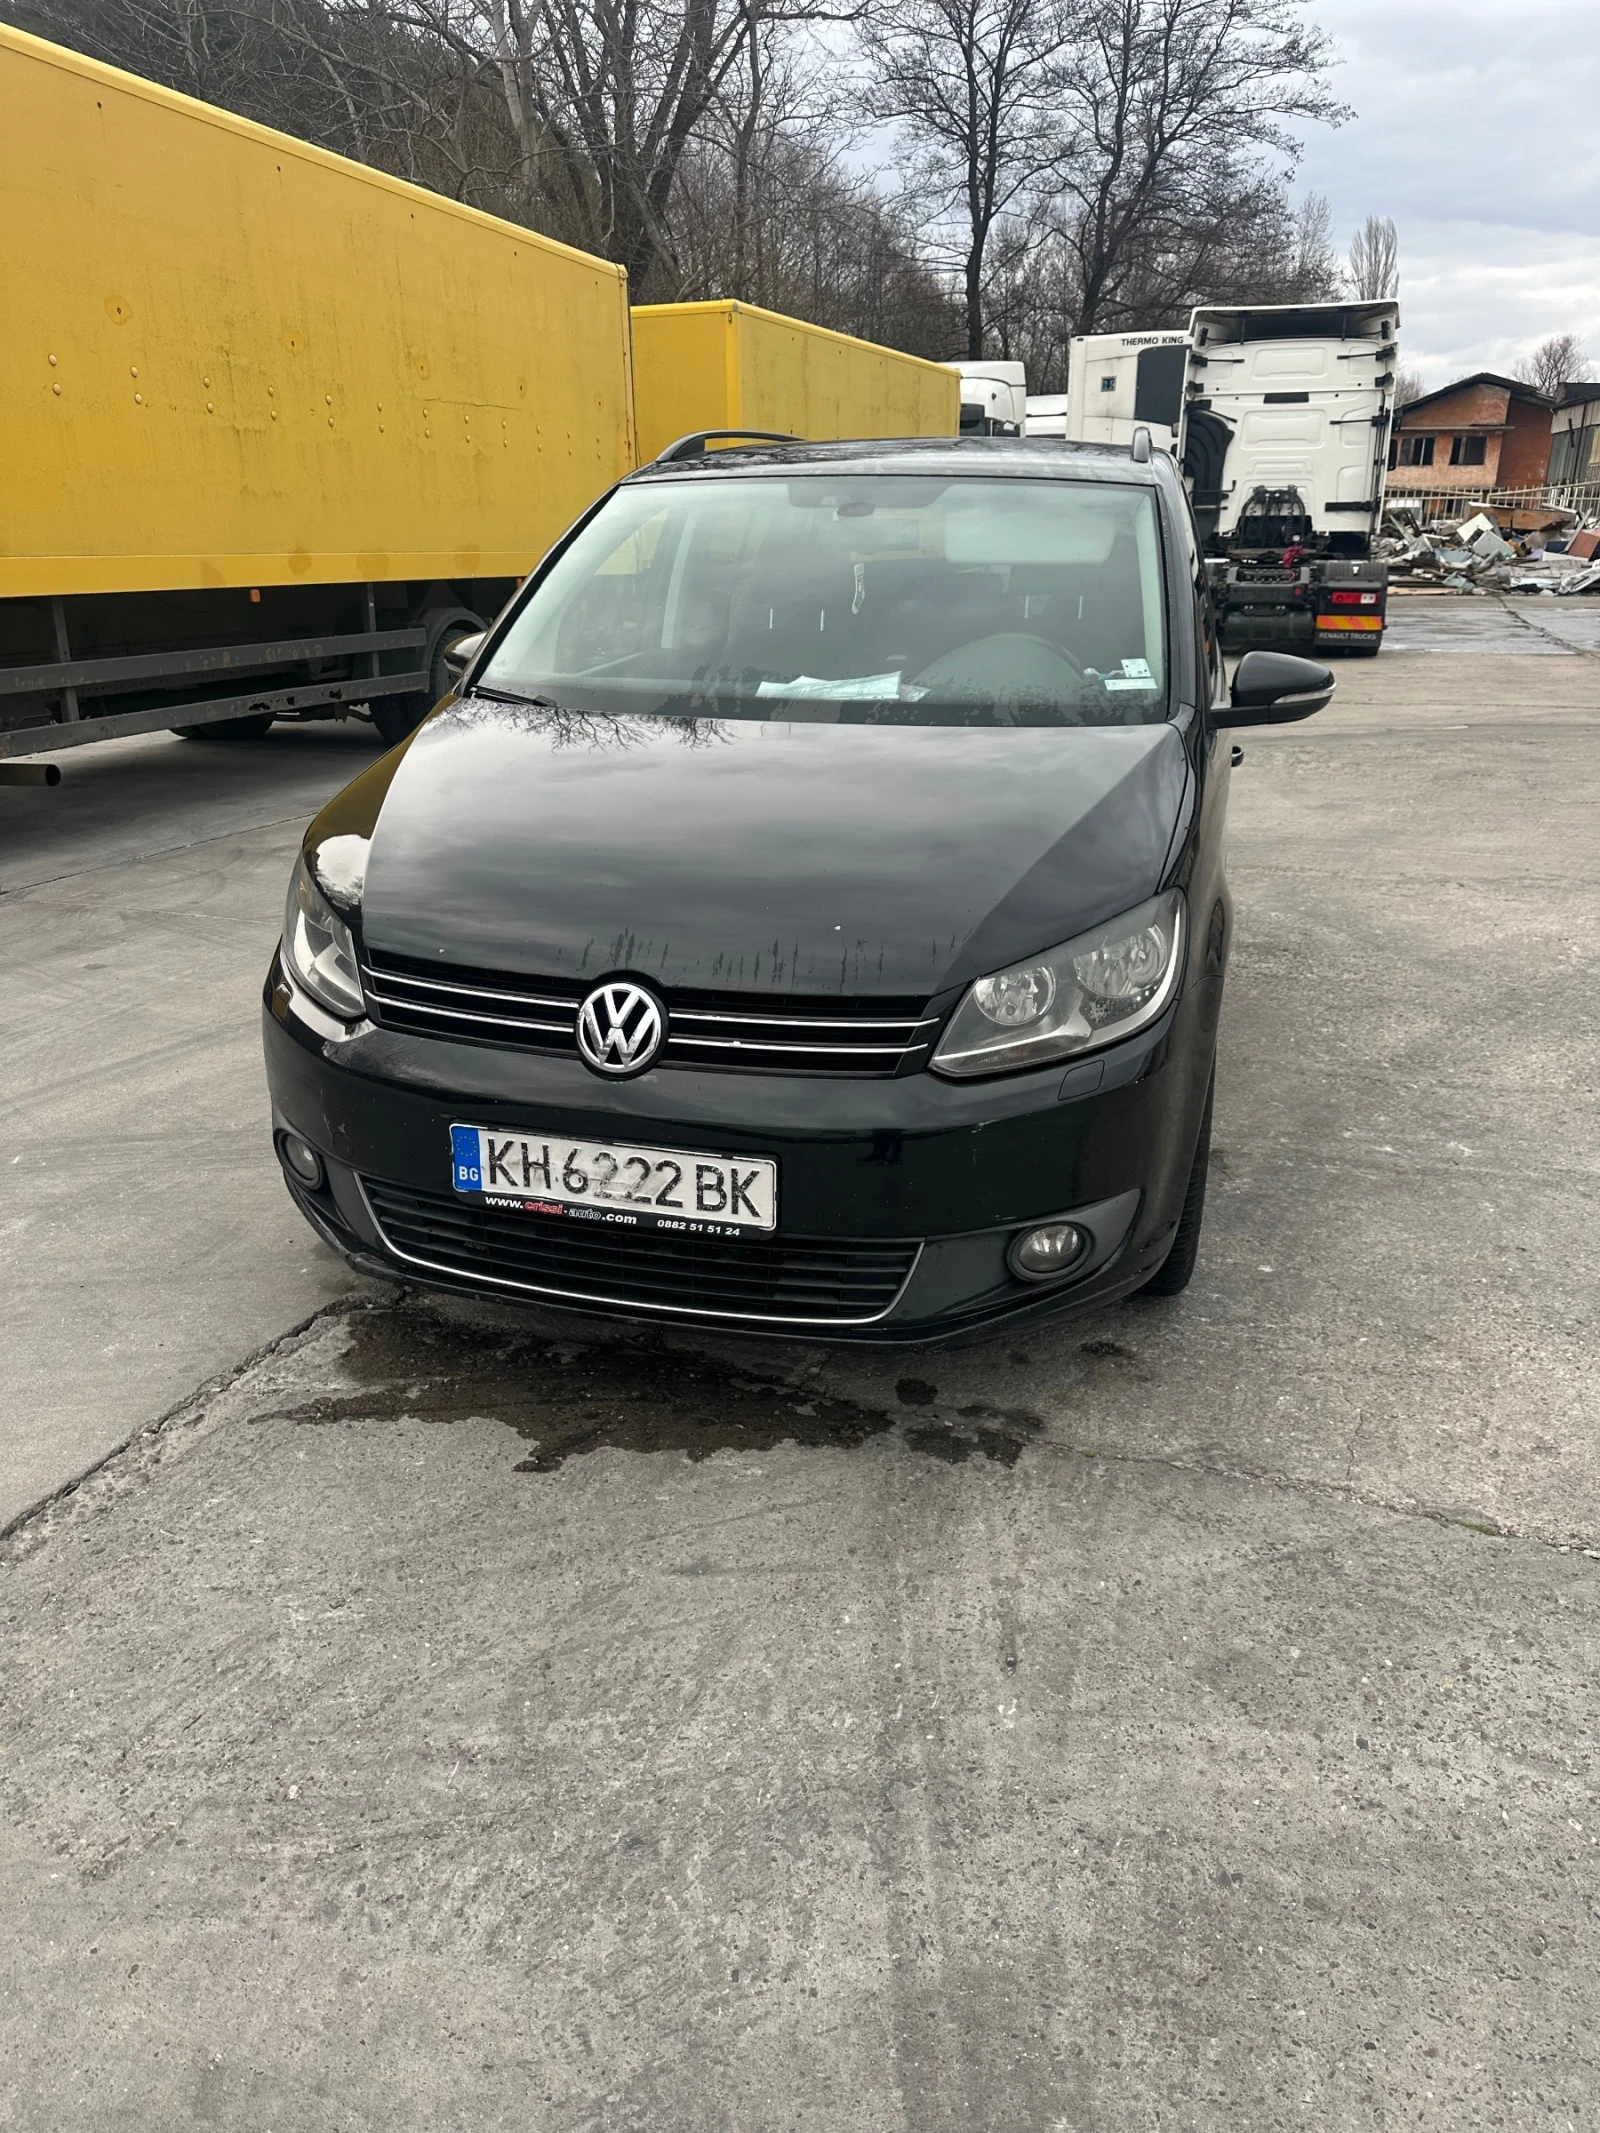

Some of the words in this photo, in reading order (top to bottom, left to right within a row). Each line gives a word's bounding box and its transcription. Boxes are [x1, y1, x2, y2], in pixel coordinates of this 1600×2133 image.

[1121, 336, 1159, 346] THERMO
[1162, 336, 1184, 344] KING
[1319, 632, 1349, 640] RENAULT
[1350, 632, 1377, 640] TRUCKS
[458, 1165, 479, 1182] BG
[484, 1196, 637, 1225] www.crissi-auto.com
[657, 1219, 687, 1230] 0882
[689, 1223, 703, 1232] 51
[707, 1225, 721, 1234] 51
[724, 1227, 740, 1236] 24
